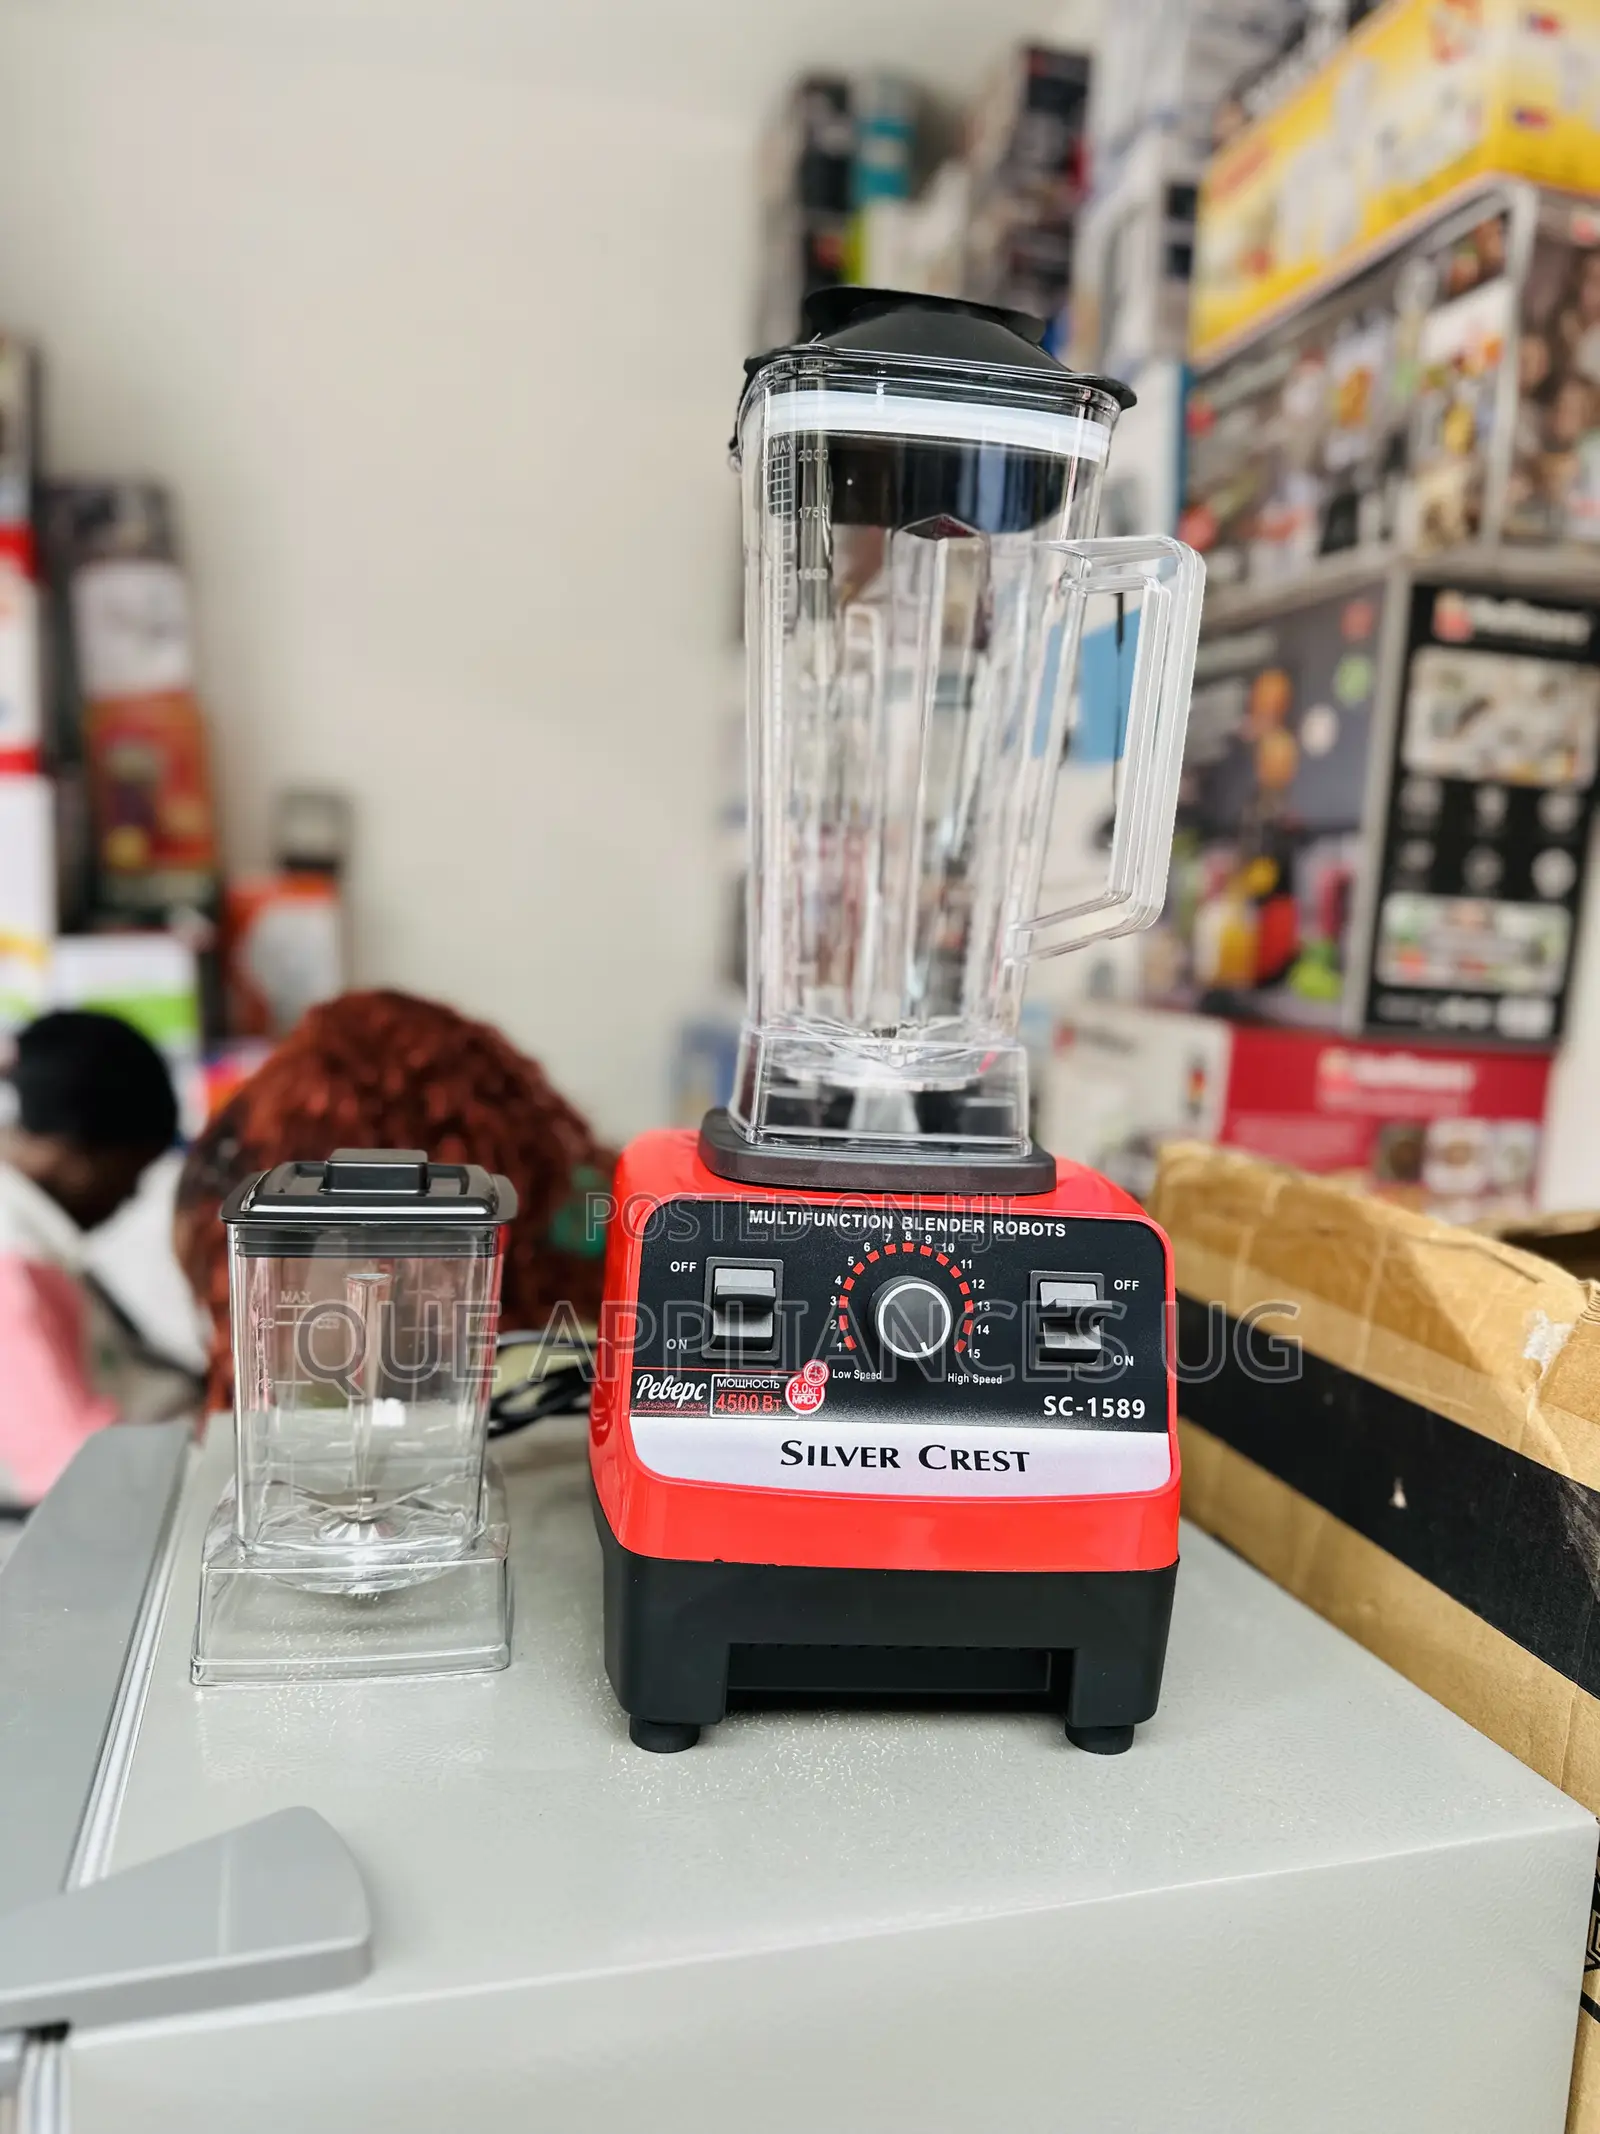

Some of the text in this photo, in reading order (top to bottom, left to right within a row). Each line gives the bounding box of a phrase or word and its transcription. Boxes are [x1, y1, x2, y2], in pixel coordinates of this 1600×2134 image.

[797, 448, 829, 463] 2000
[749, 1209, 1067, 1237] MULTIFUNCTION BLENDER ROBOTS
[885, 1233, 892, 1243] 7
[904, 1231, 912, 1241] 8
[925, 1234, 932, 1244] 9
[863, 1242, 871, 1252] 6
[941, 1243, 955, 1253] 10
[847, 1256, 855, 1266] 5
[960, 1259, 972, 1269] 11
[670, 1261, 698, 1273] OFF
[834, 1275, 842, 1286] 4
[971, 1279, 985, 1289] 12
[1113, 1279, 1140, 1291] OFF
[280, 1290, 312, 1304] MAX
[830, 1296, 837, 1306] 3
[977, 1302, 991, 1311] 13
[829, 1320, 837, 1330] 2
[976, 1325, 990, 1335] 14
[666, 1338, 688, 1350] ON
[967, 1349, 981, 1359] 15
[1113, 1355, 1134, 1367] ON
[832, 1368, 882, 1381] Low Speed
[947, 1372, 1003, 1386] High Speed
[716, 1378, 780, 1390] МОЩНОСТЬ
[635, 1373, 708, 1409] Реверс
[714, 1393, 760, 1413] 4500
[1043, 1395, 1146, 1419] SC-1589
[780, 1439, 1031, 1472] SILVER CREST
